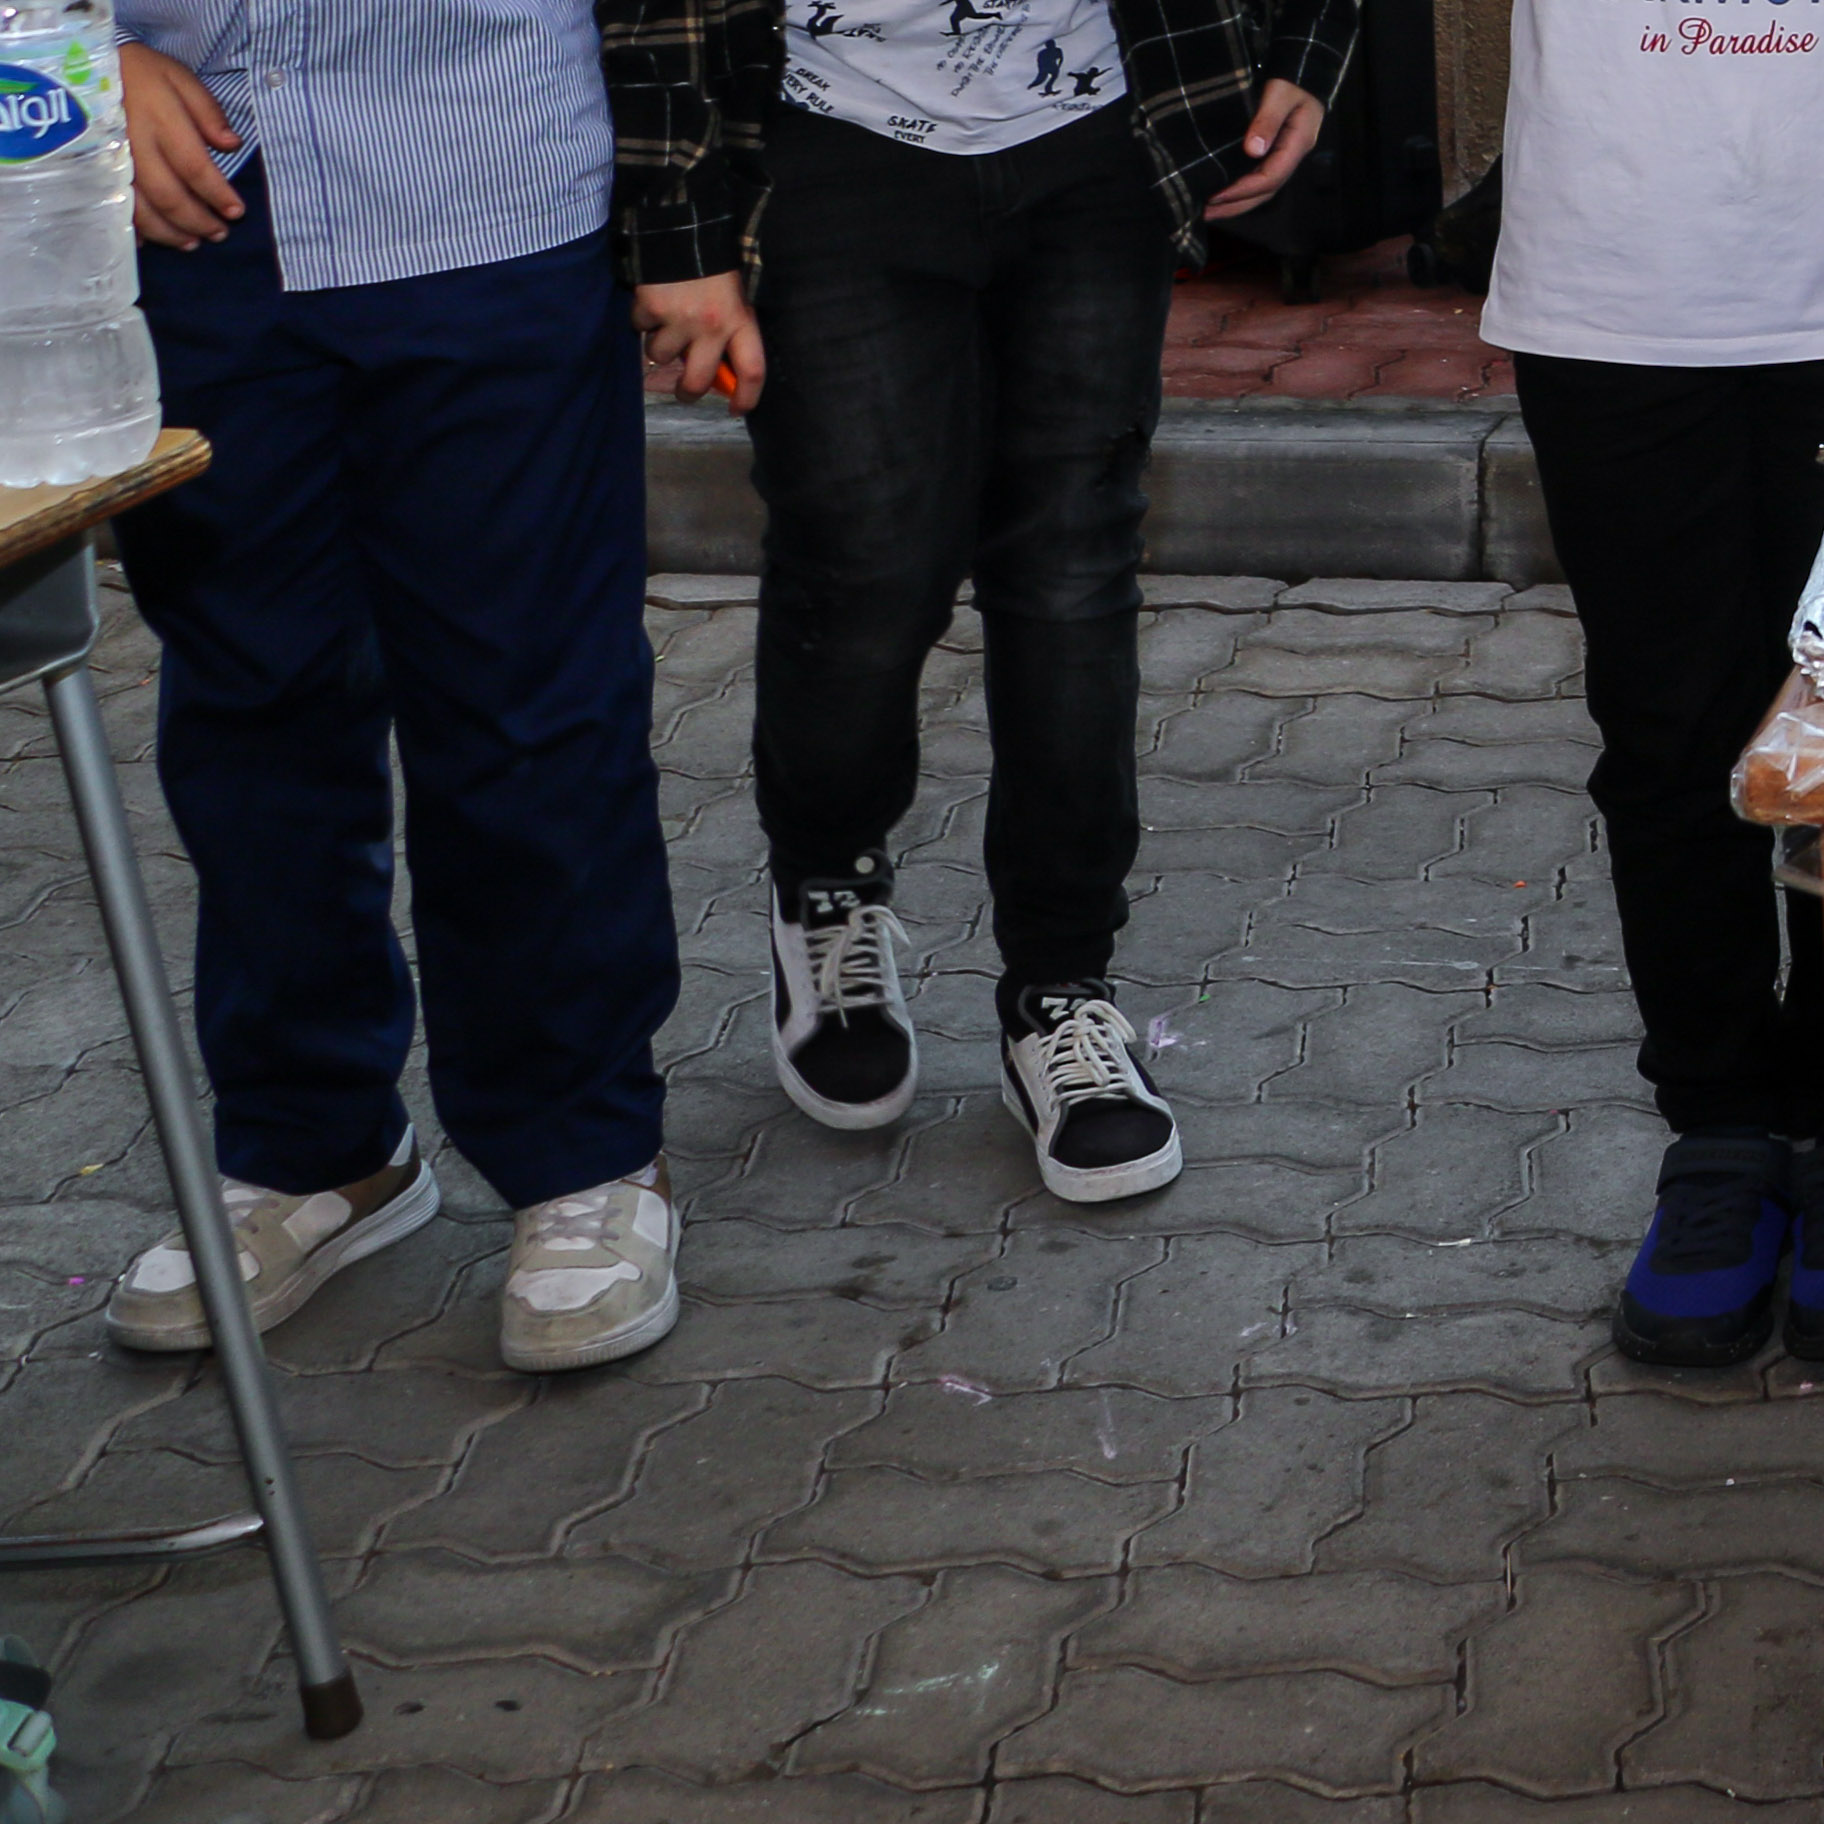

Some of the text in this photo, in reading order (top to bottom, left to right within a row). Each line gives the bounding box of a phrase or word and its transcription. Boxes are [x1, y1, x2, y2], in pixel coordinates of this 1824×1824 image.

[1639, 16, 1820, 56] in Paradise
[783, 74, 809, 96] VERY
[795, 67, 831, 92] BREAK
[887, 114, 938, 134] SKATE
